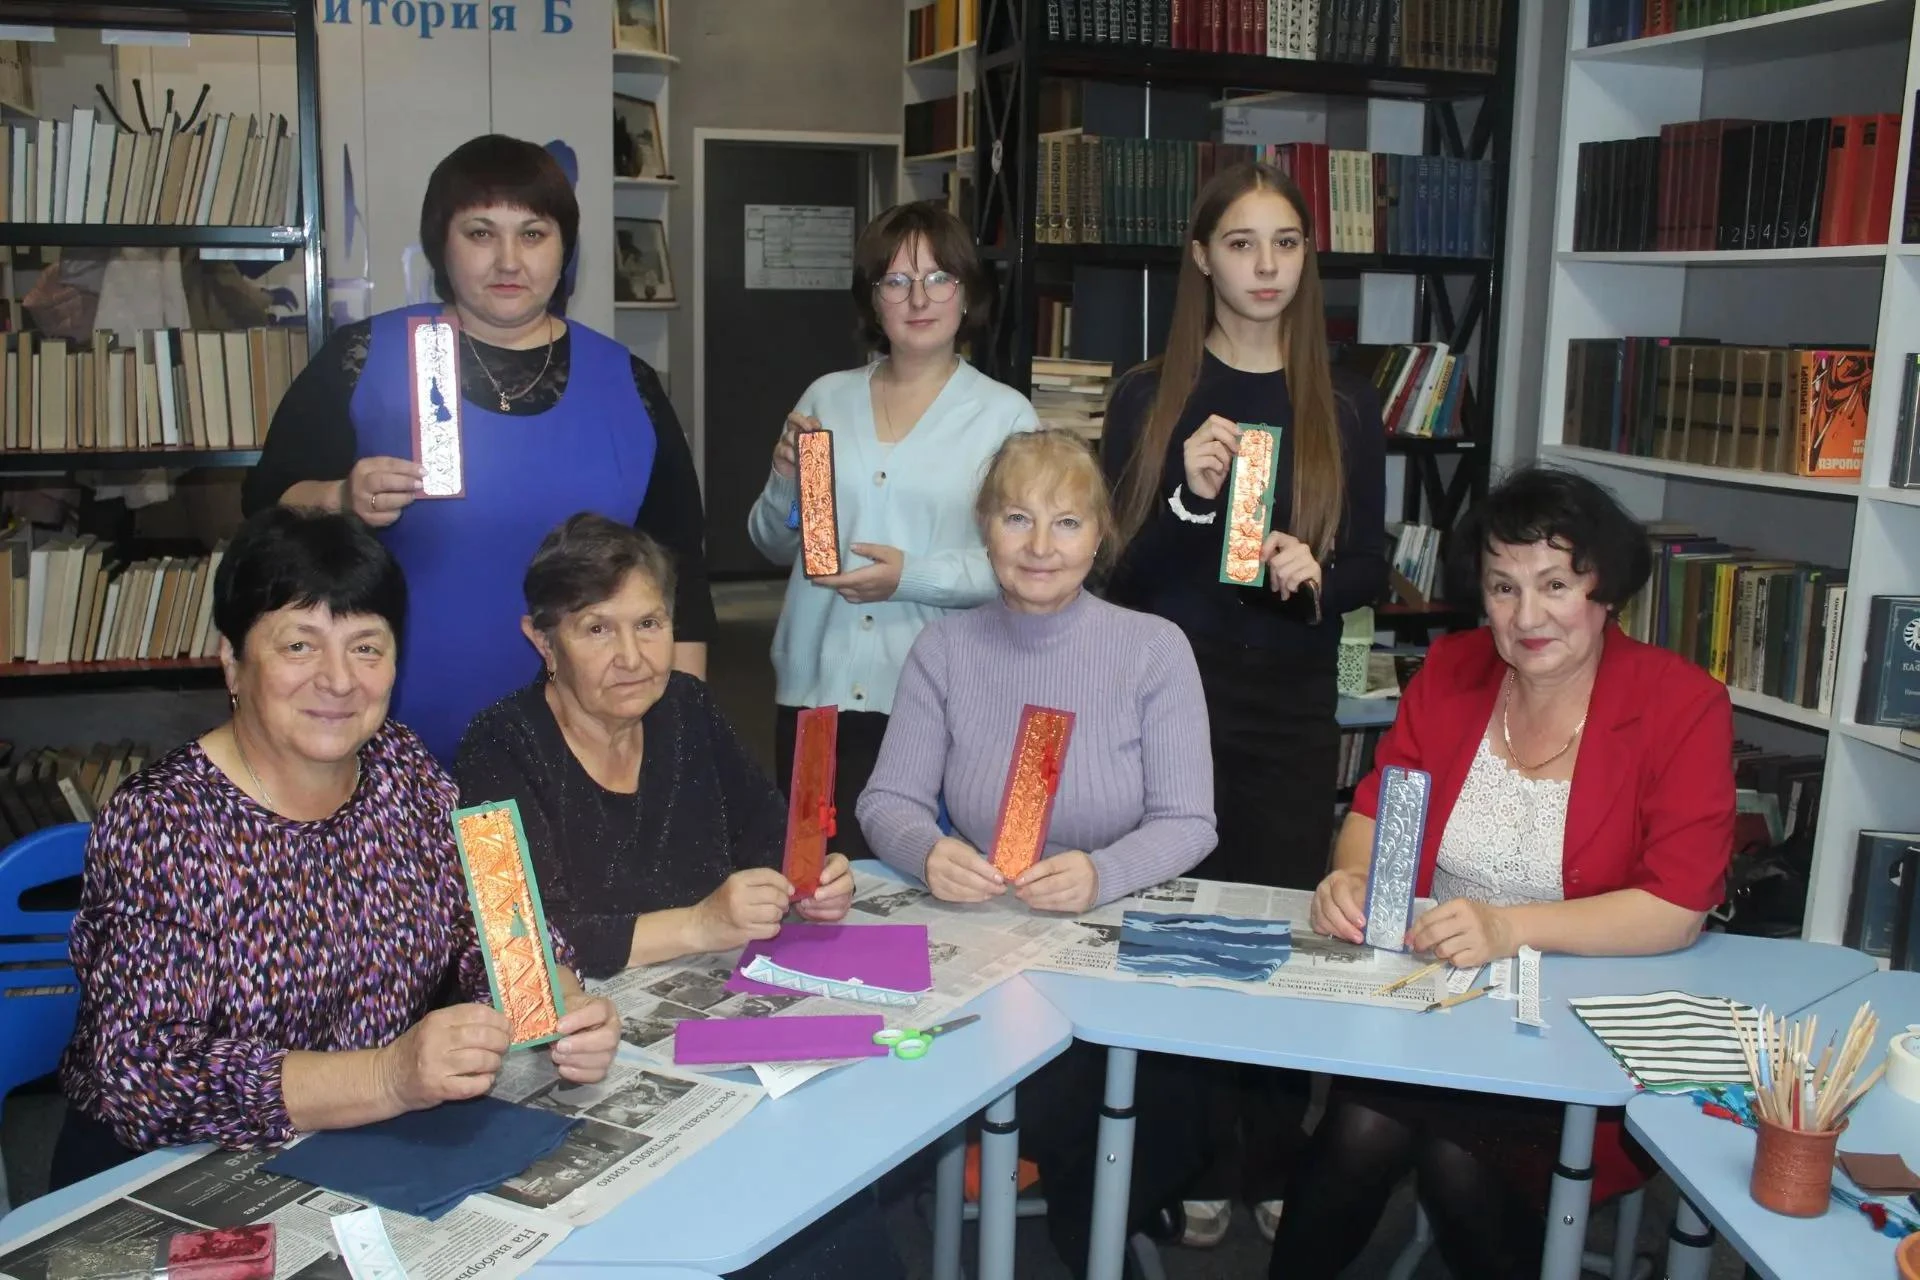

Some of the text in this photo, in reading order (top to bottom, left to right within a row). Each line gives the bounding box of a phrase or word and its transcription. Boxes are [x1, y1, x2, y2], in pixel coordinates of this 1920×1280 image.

[322, 0, 574, 39] итория Б
[1719, 226, 1724, 242] 1
[1732, 227, 1740, 242] 2
[1747, 224, 1756, 240] 3
[1762, 224, 1771, 240] 4
[1780, 221, 1791, 238] 5
[1798, 221, 1808, 238] 6
[1817, 457, 1864, 472] АЭРОПО
[512, 1227, 537, 1244] На
